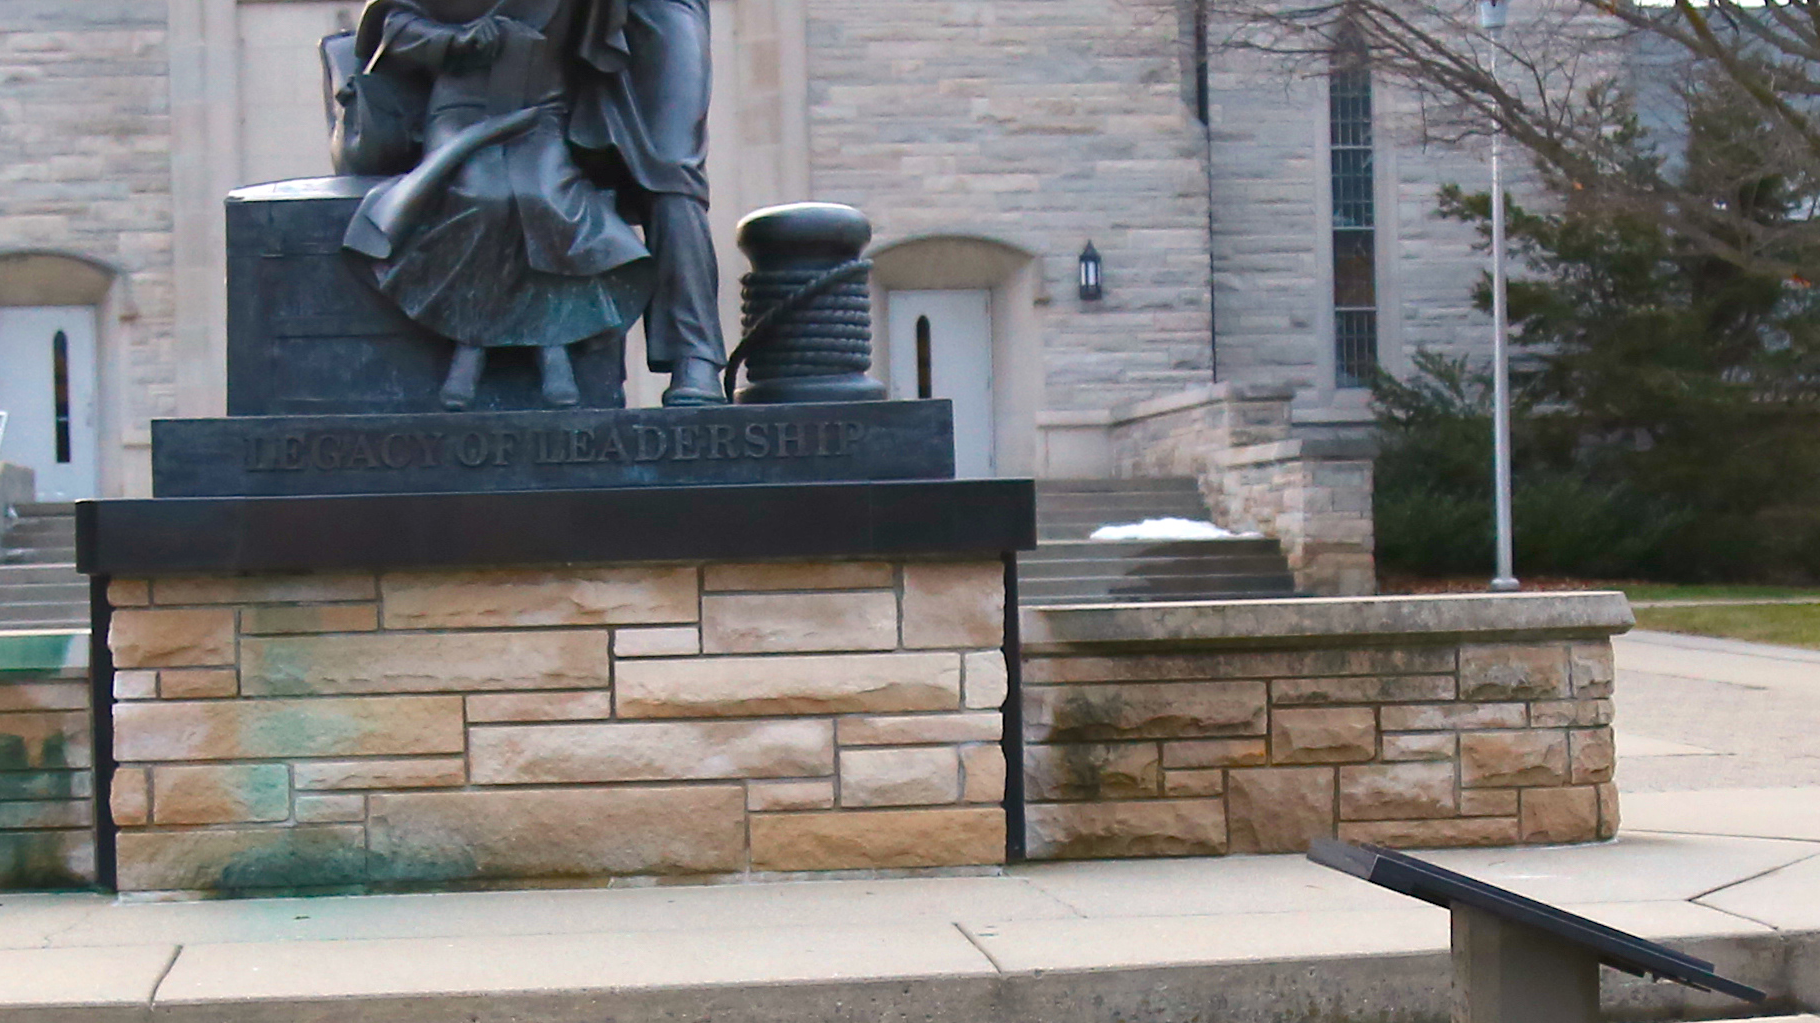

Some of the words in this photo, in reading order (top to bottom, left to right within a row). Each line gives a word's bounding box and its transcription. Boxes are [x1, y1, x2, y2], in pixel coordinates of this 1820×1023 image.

[244, 431, 445, 472] LEGACY
[457, 429, 519, 467] OF
[533, 421, 865, 464] LEADERSHIP
